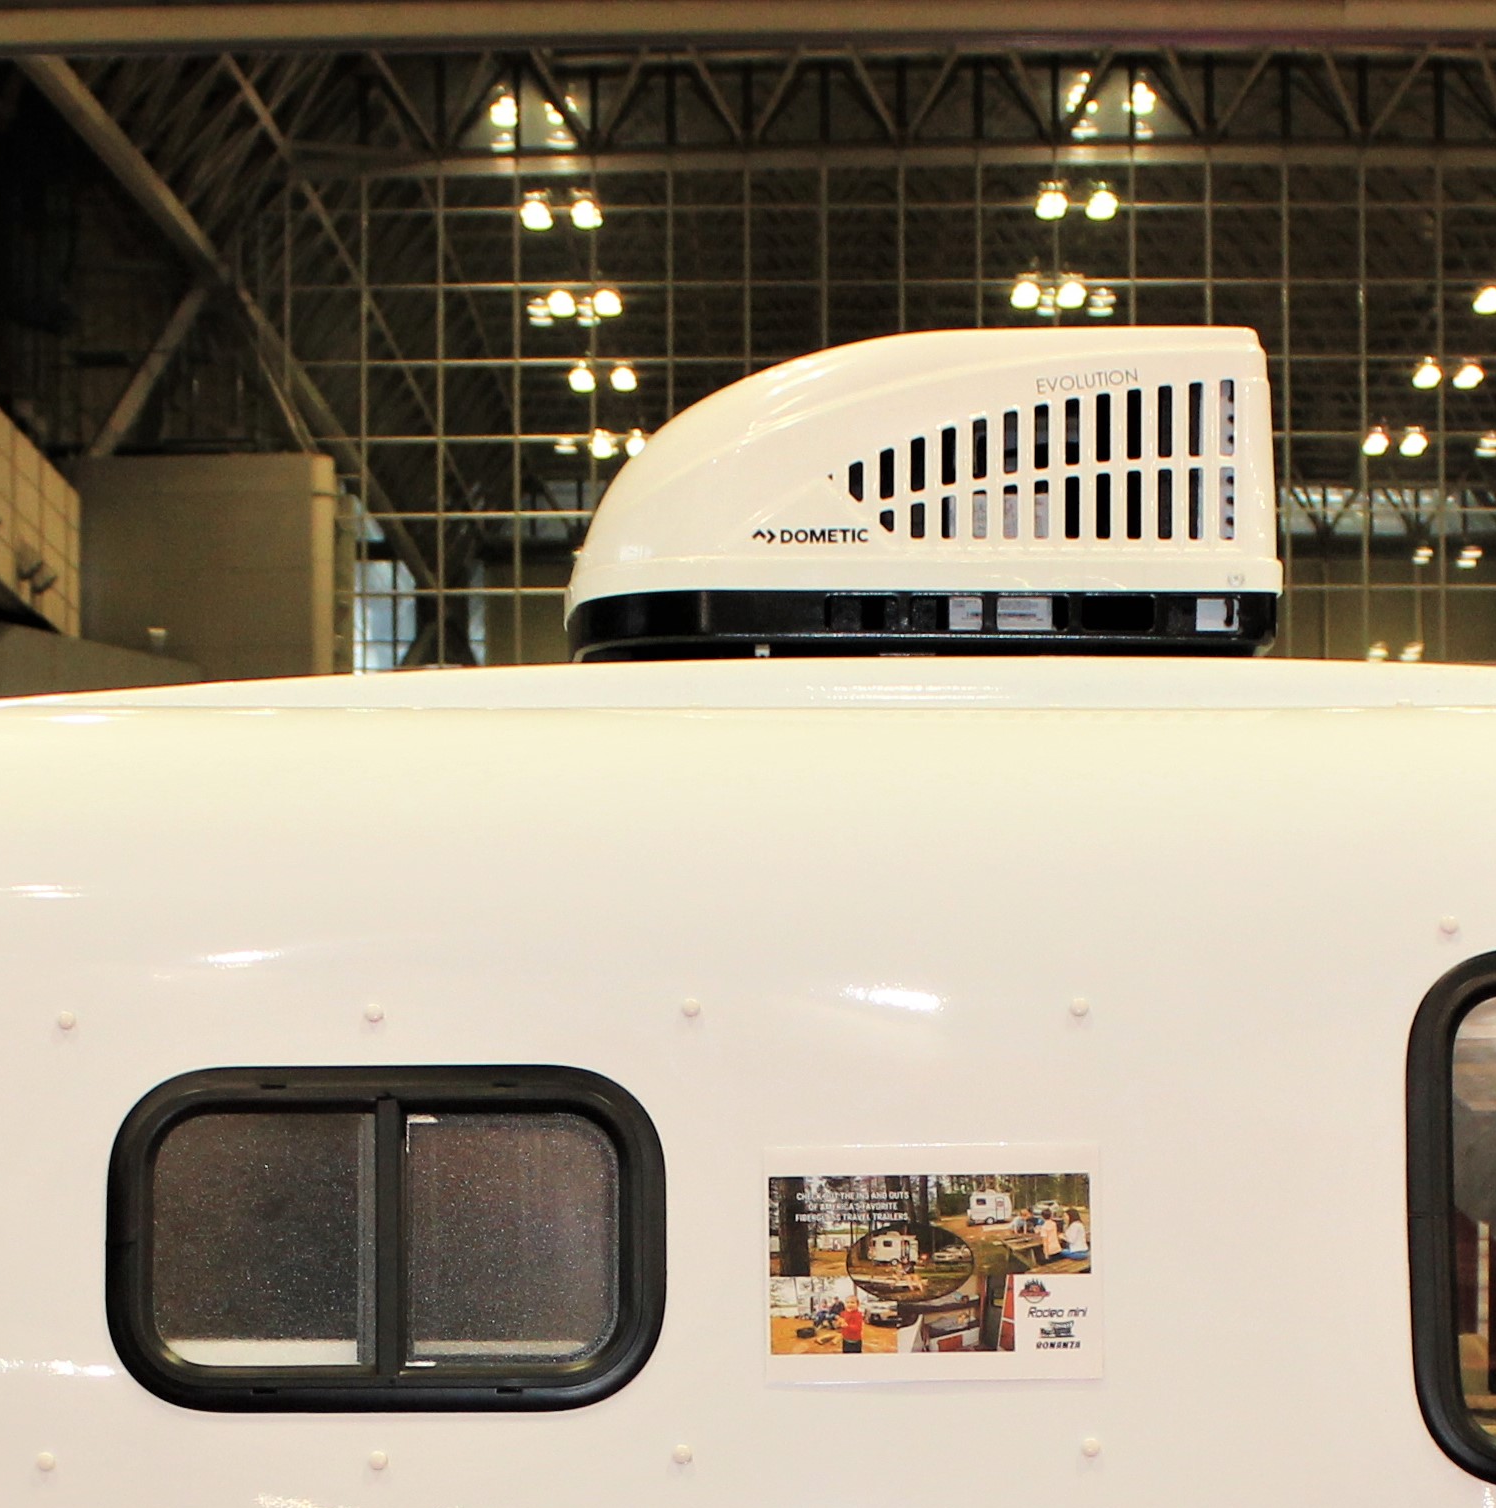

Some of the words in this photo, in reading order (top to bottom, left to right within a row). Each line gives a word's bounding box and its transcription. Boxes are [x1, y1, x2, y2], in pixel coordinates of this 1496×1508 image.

[1035, 367, 1139, 396] EVOLUTION
[780, 528, 870, 544] DOMETIC
[1028, 1306, 1064, 1318] Rodeo
